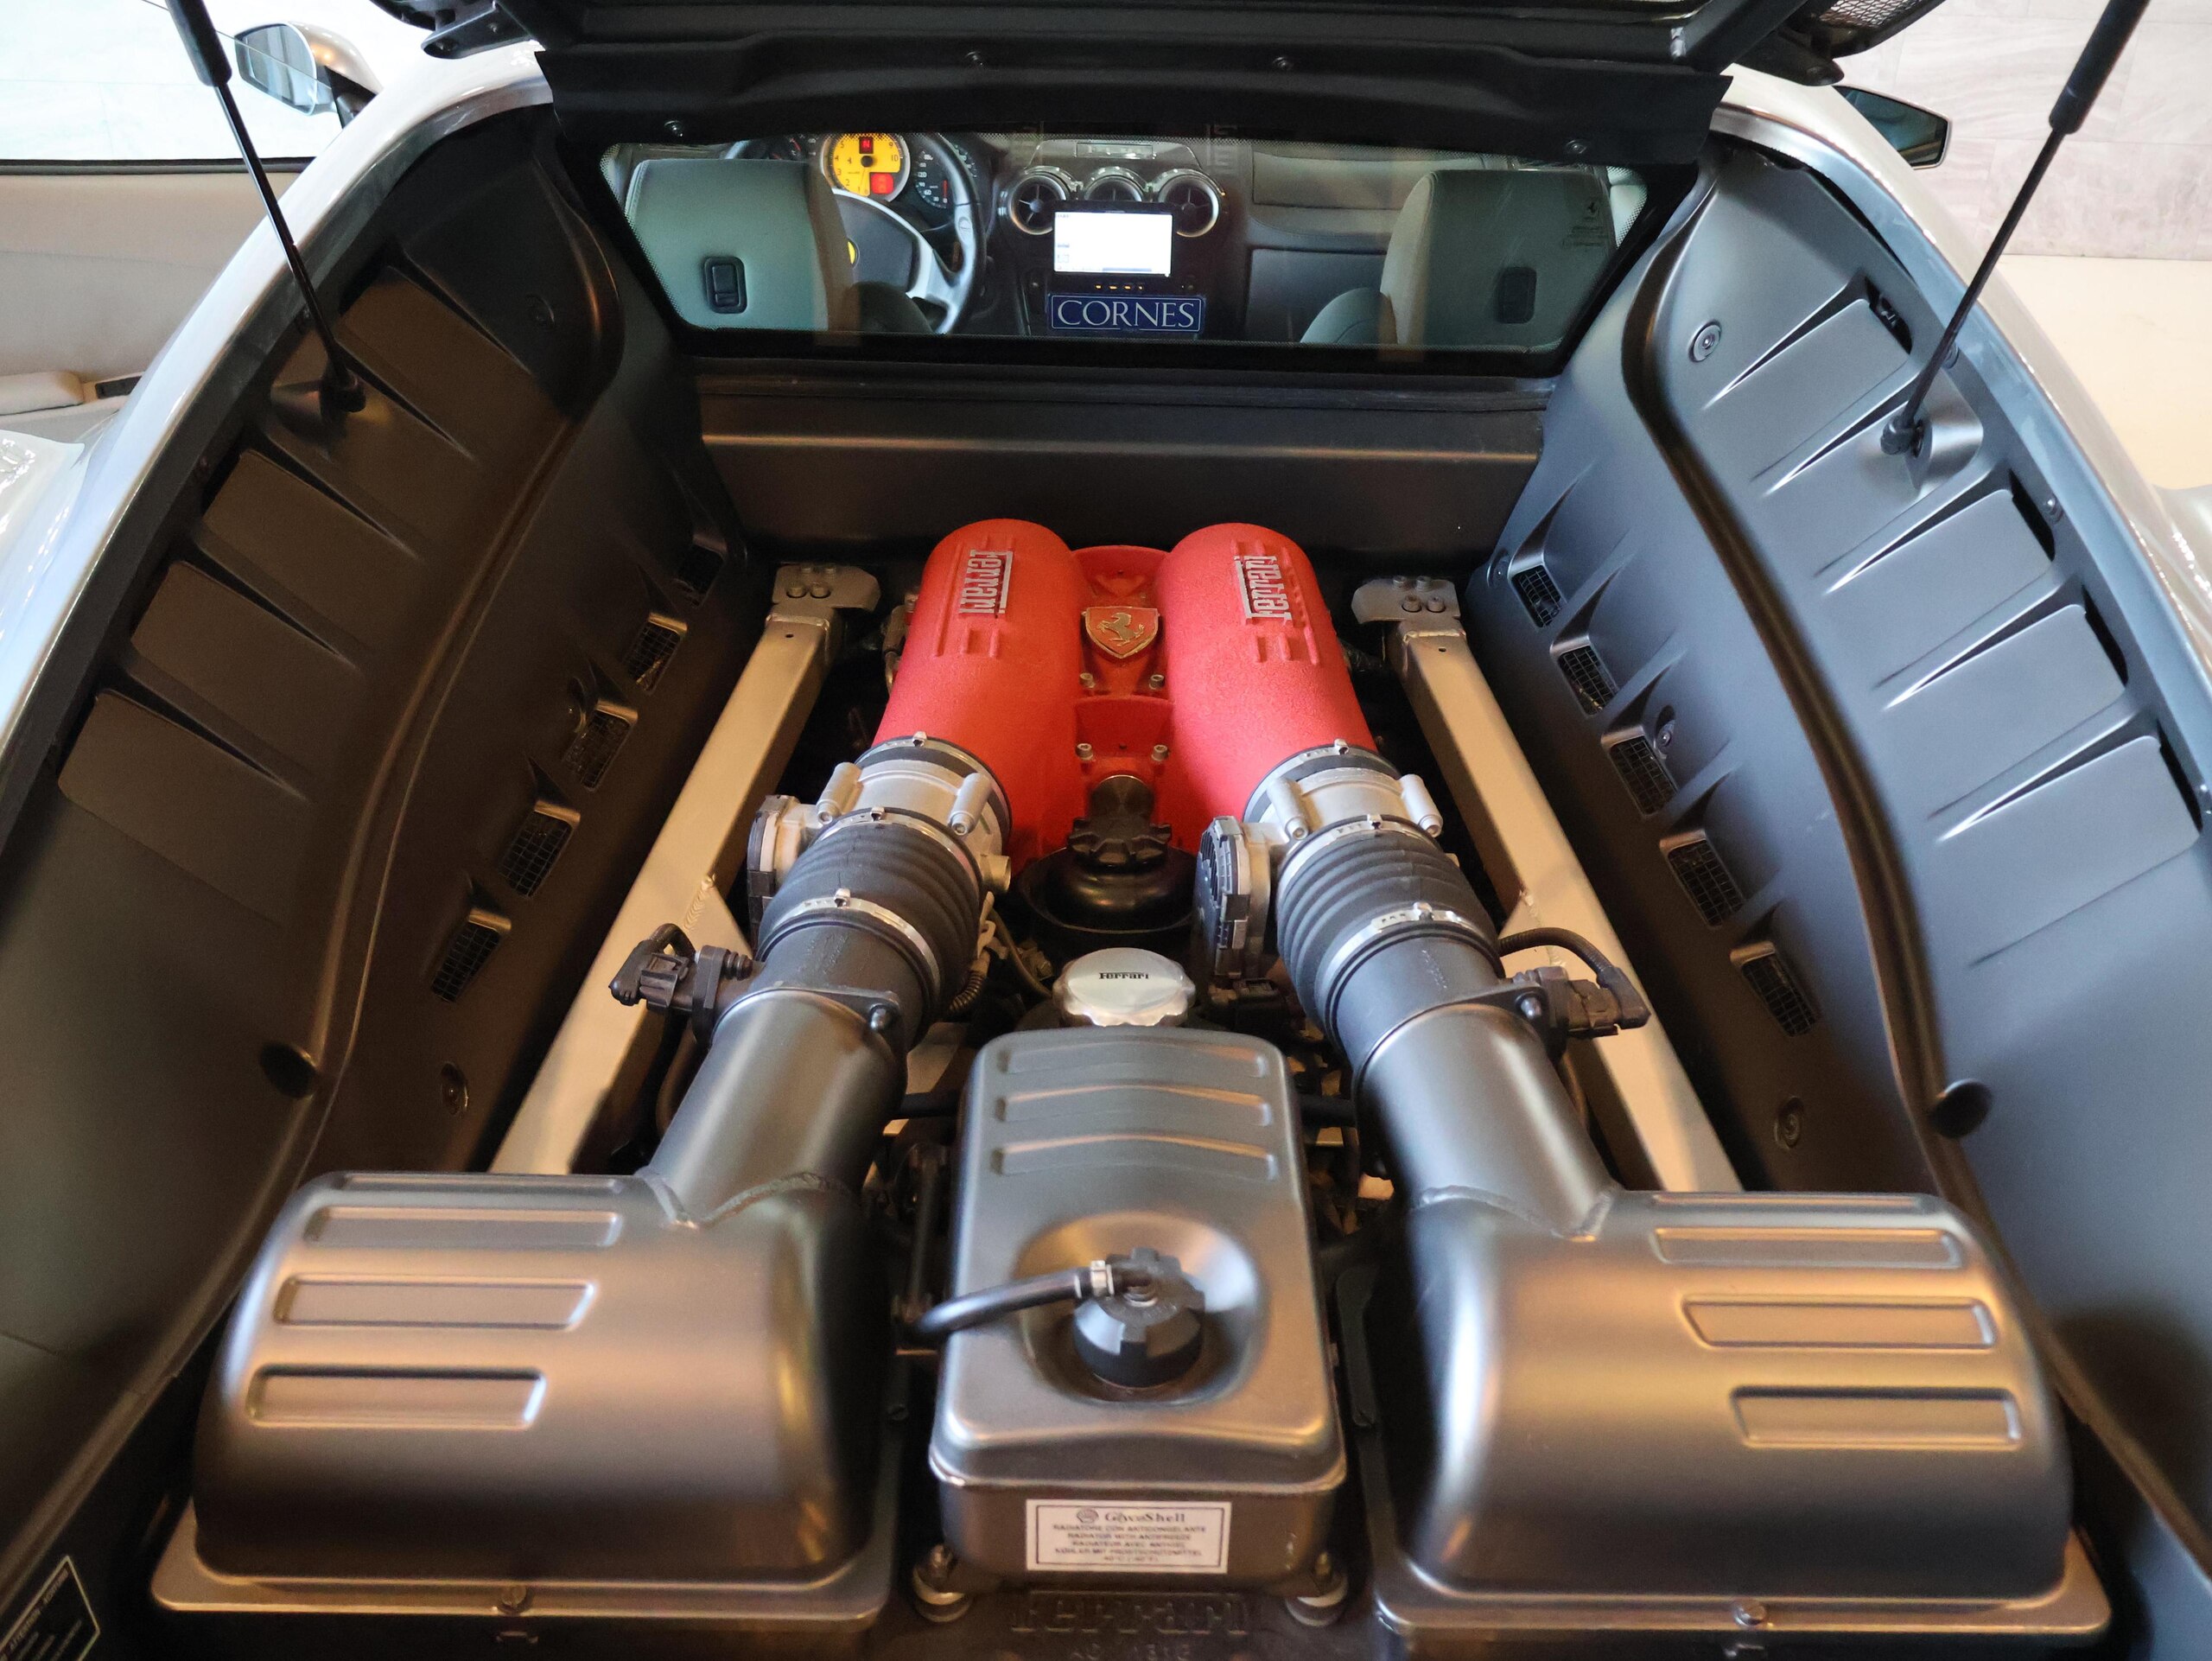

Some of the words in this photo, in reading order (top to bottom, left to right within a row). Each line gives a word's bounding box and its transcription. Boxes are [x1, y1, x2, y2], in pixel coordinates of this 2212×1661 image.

[1057, 299, 1195, 328] CORNES
[958, 549, 1014, 614] Ferrari
[1232, 554, 1294, 621] Ferrari
[1098, 971, 1150, 980] Ferrari
